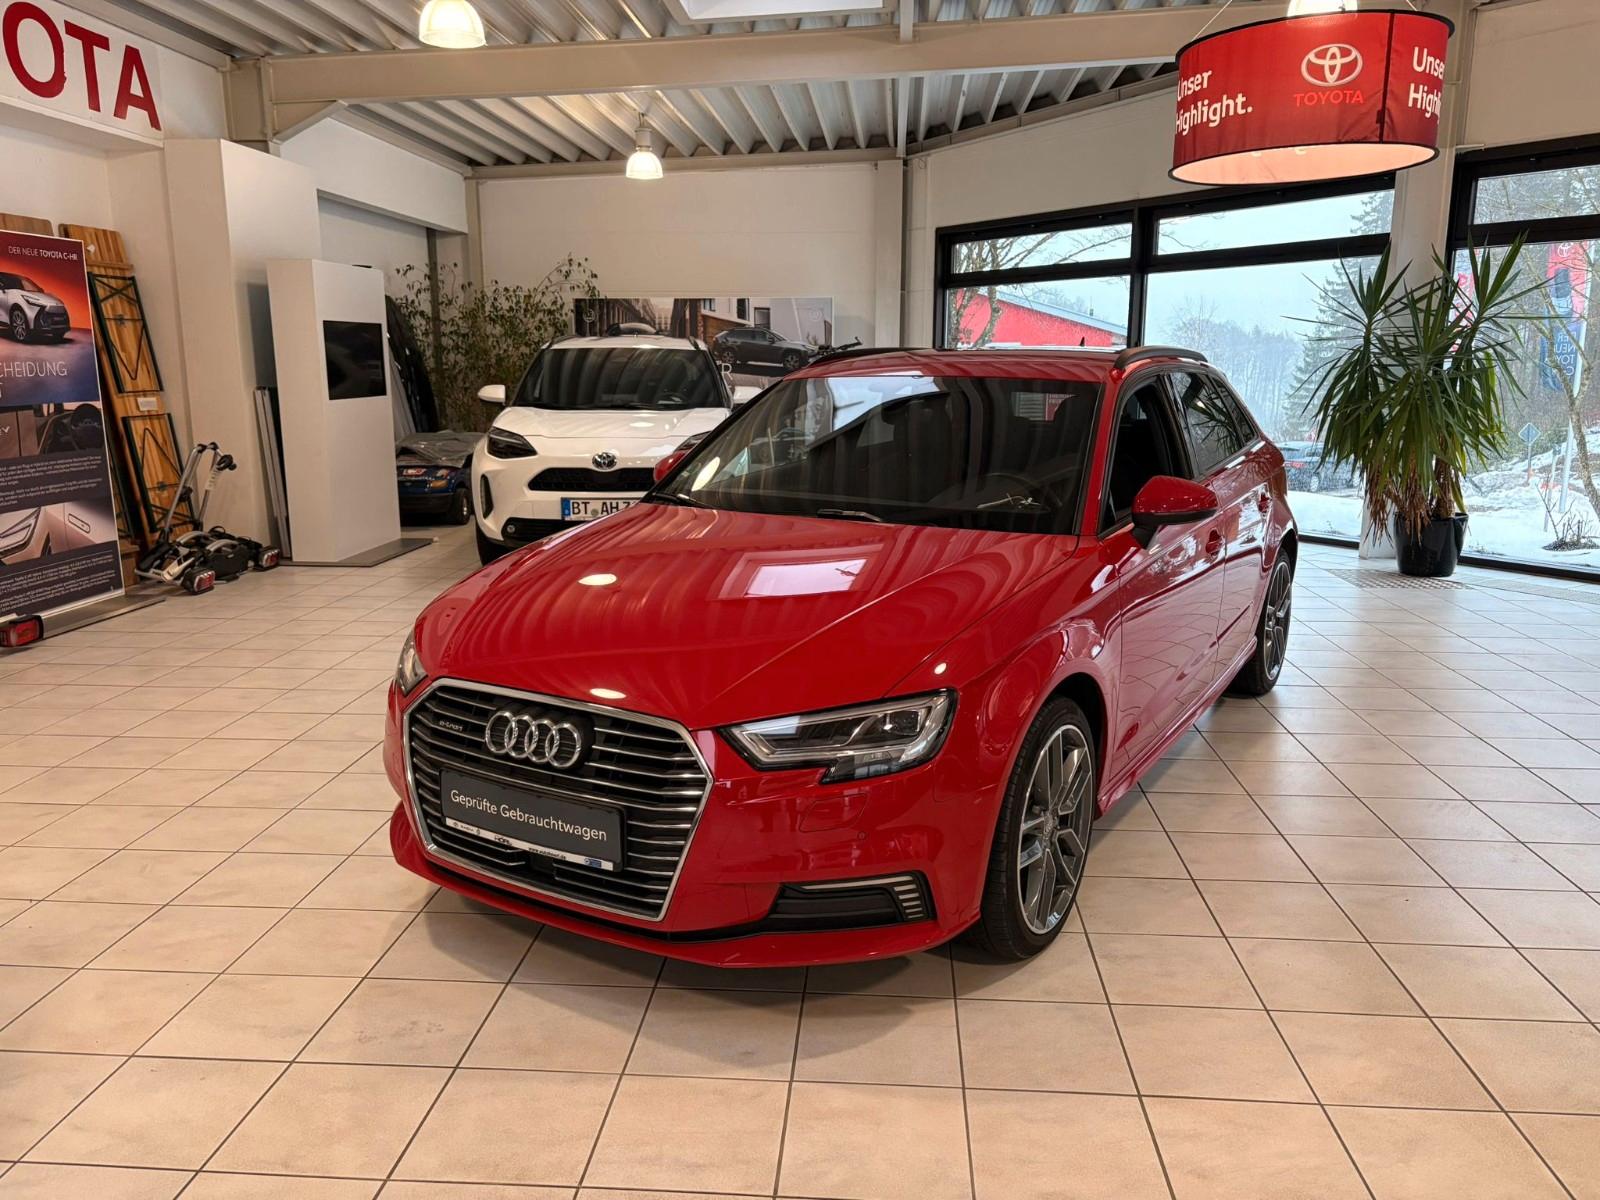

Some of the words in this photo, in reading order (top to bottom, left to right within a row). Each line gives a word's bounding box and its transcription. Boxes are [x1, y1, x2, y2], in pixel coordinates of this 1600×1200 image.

[1177, 70, 1212, 101] Unser
[1294, 89, 1364, 107] TOYOTA
[1175, 92, 1254, 136] Highlight.
[8, 245, 21, 255] DER
[22, 247, 39, 257] NEUE
[39, 249, 63, 260] TOYOTA
[571, 501, 590, 515] BT
[600, 501, 620, 514] AH
[450, 790, 498, 815] Geprüfte
[500, 804, 607, 841] Gebrauchtwagen
